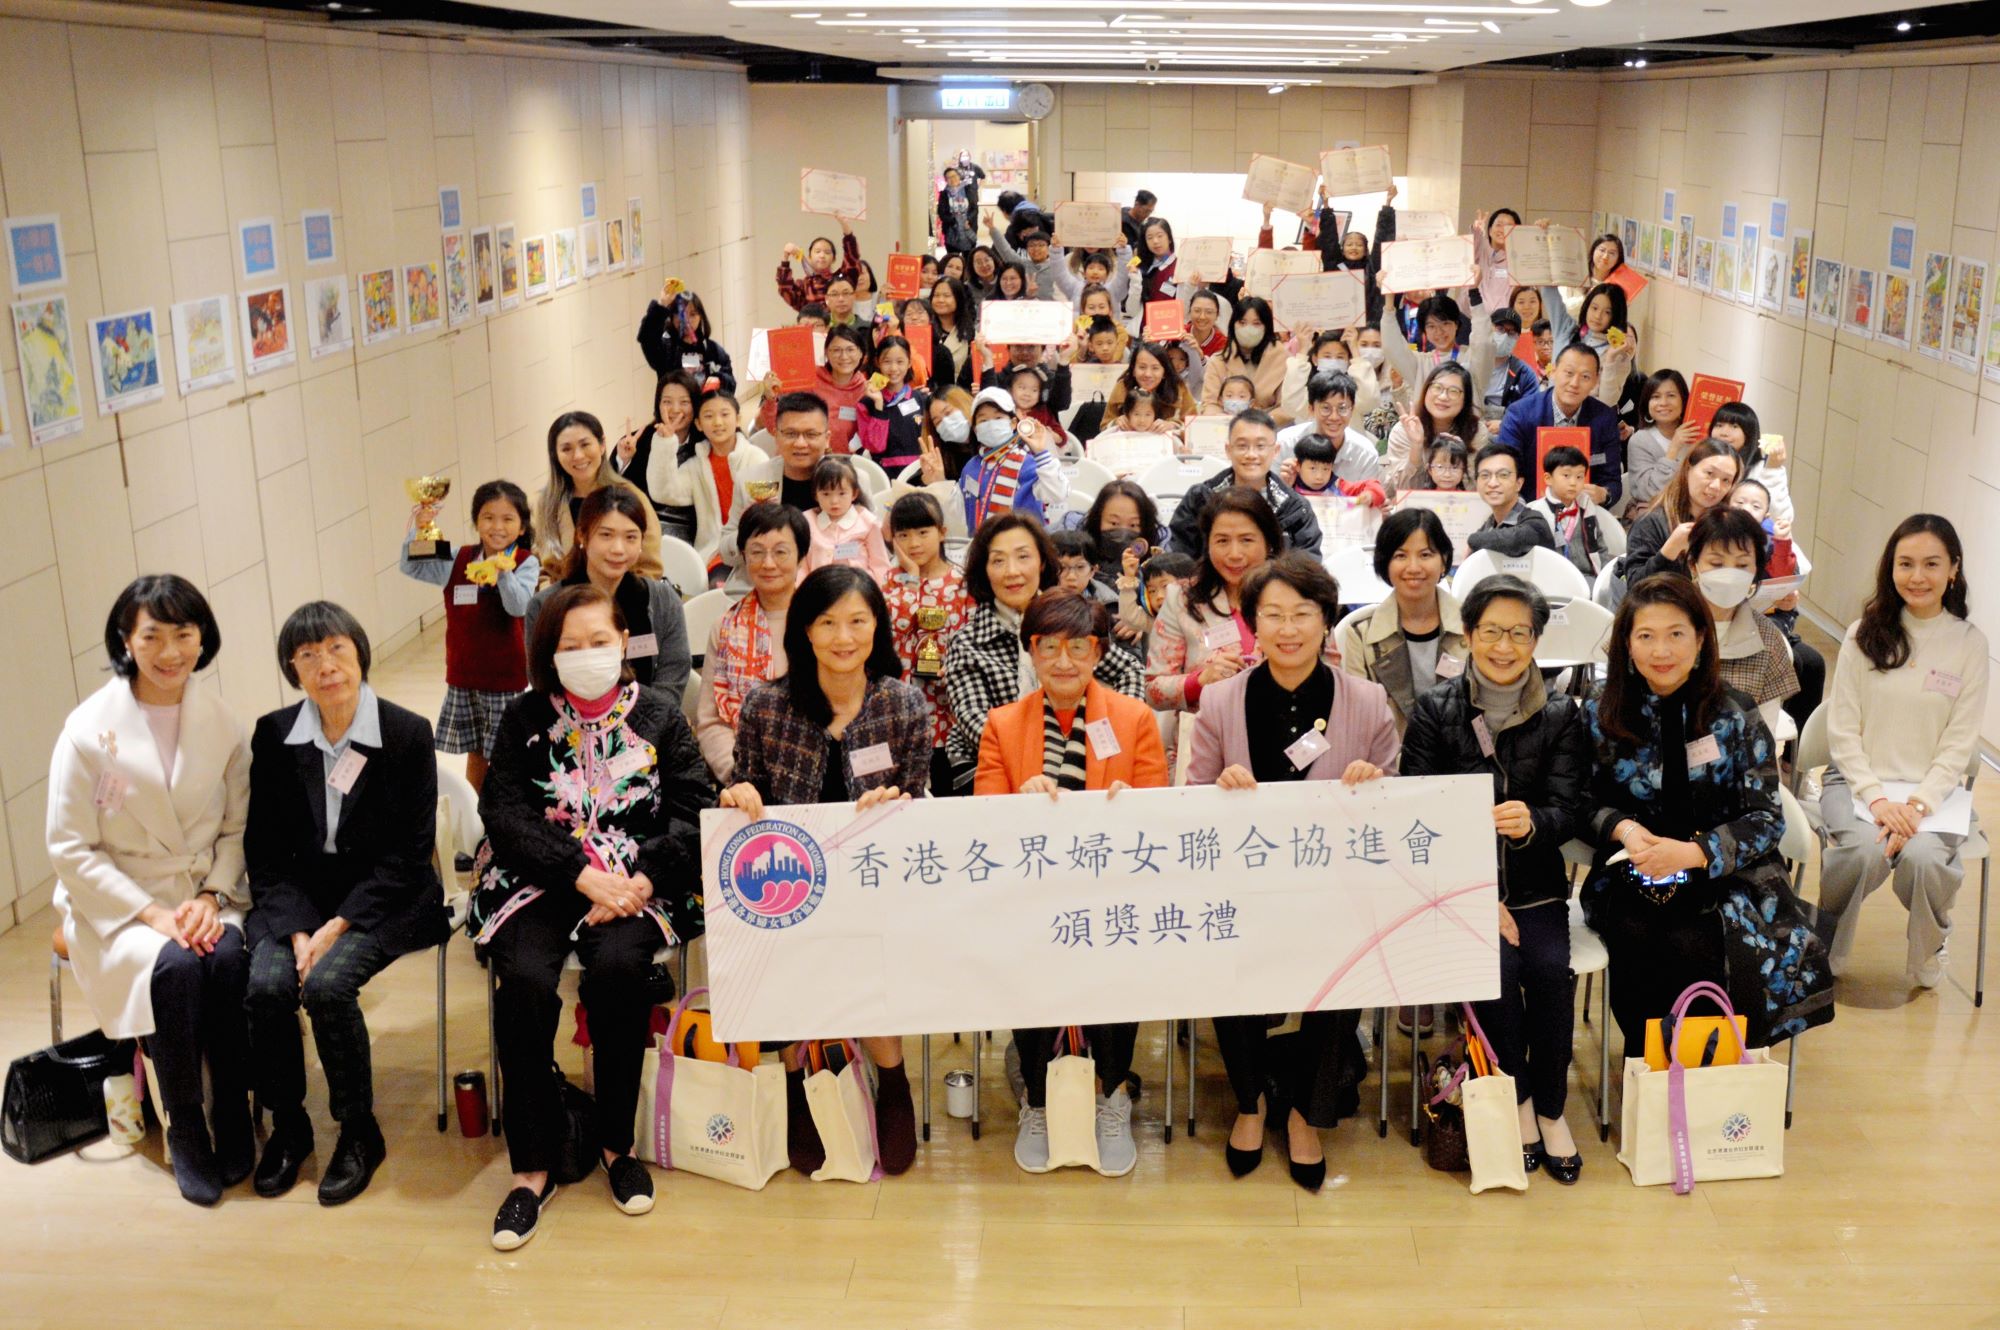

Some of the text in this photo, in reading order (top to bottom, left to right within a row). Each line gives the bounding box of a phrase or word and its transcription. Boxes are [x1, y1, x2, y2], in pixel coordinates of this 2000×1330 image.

[721, 823, 825, 880] HONG KONG FEDERATION OF WOMEN
[849, 819, 1443, 888] 香港各界婦女聯合協進會
[1050, 900, 1240, 949] 頒獎典禮
